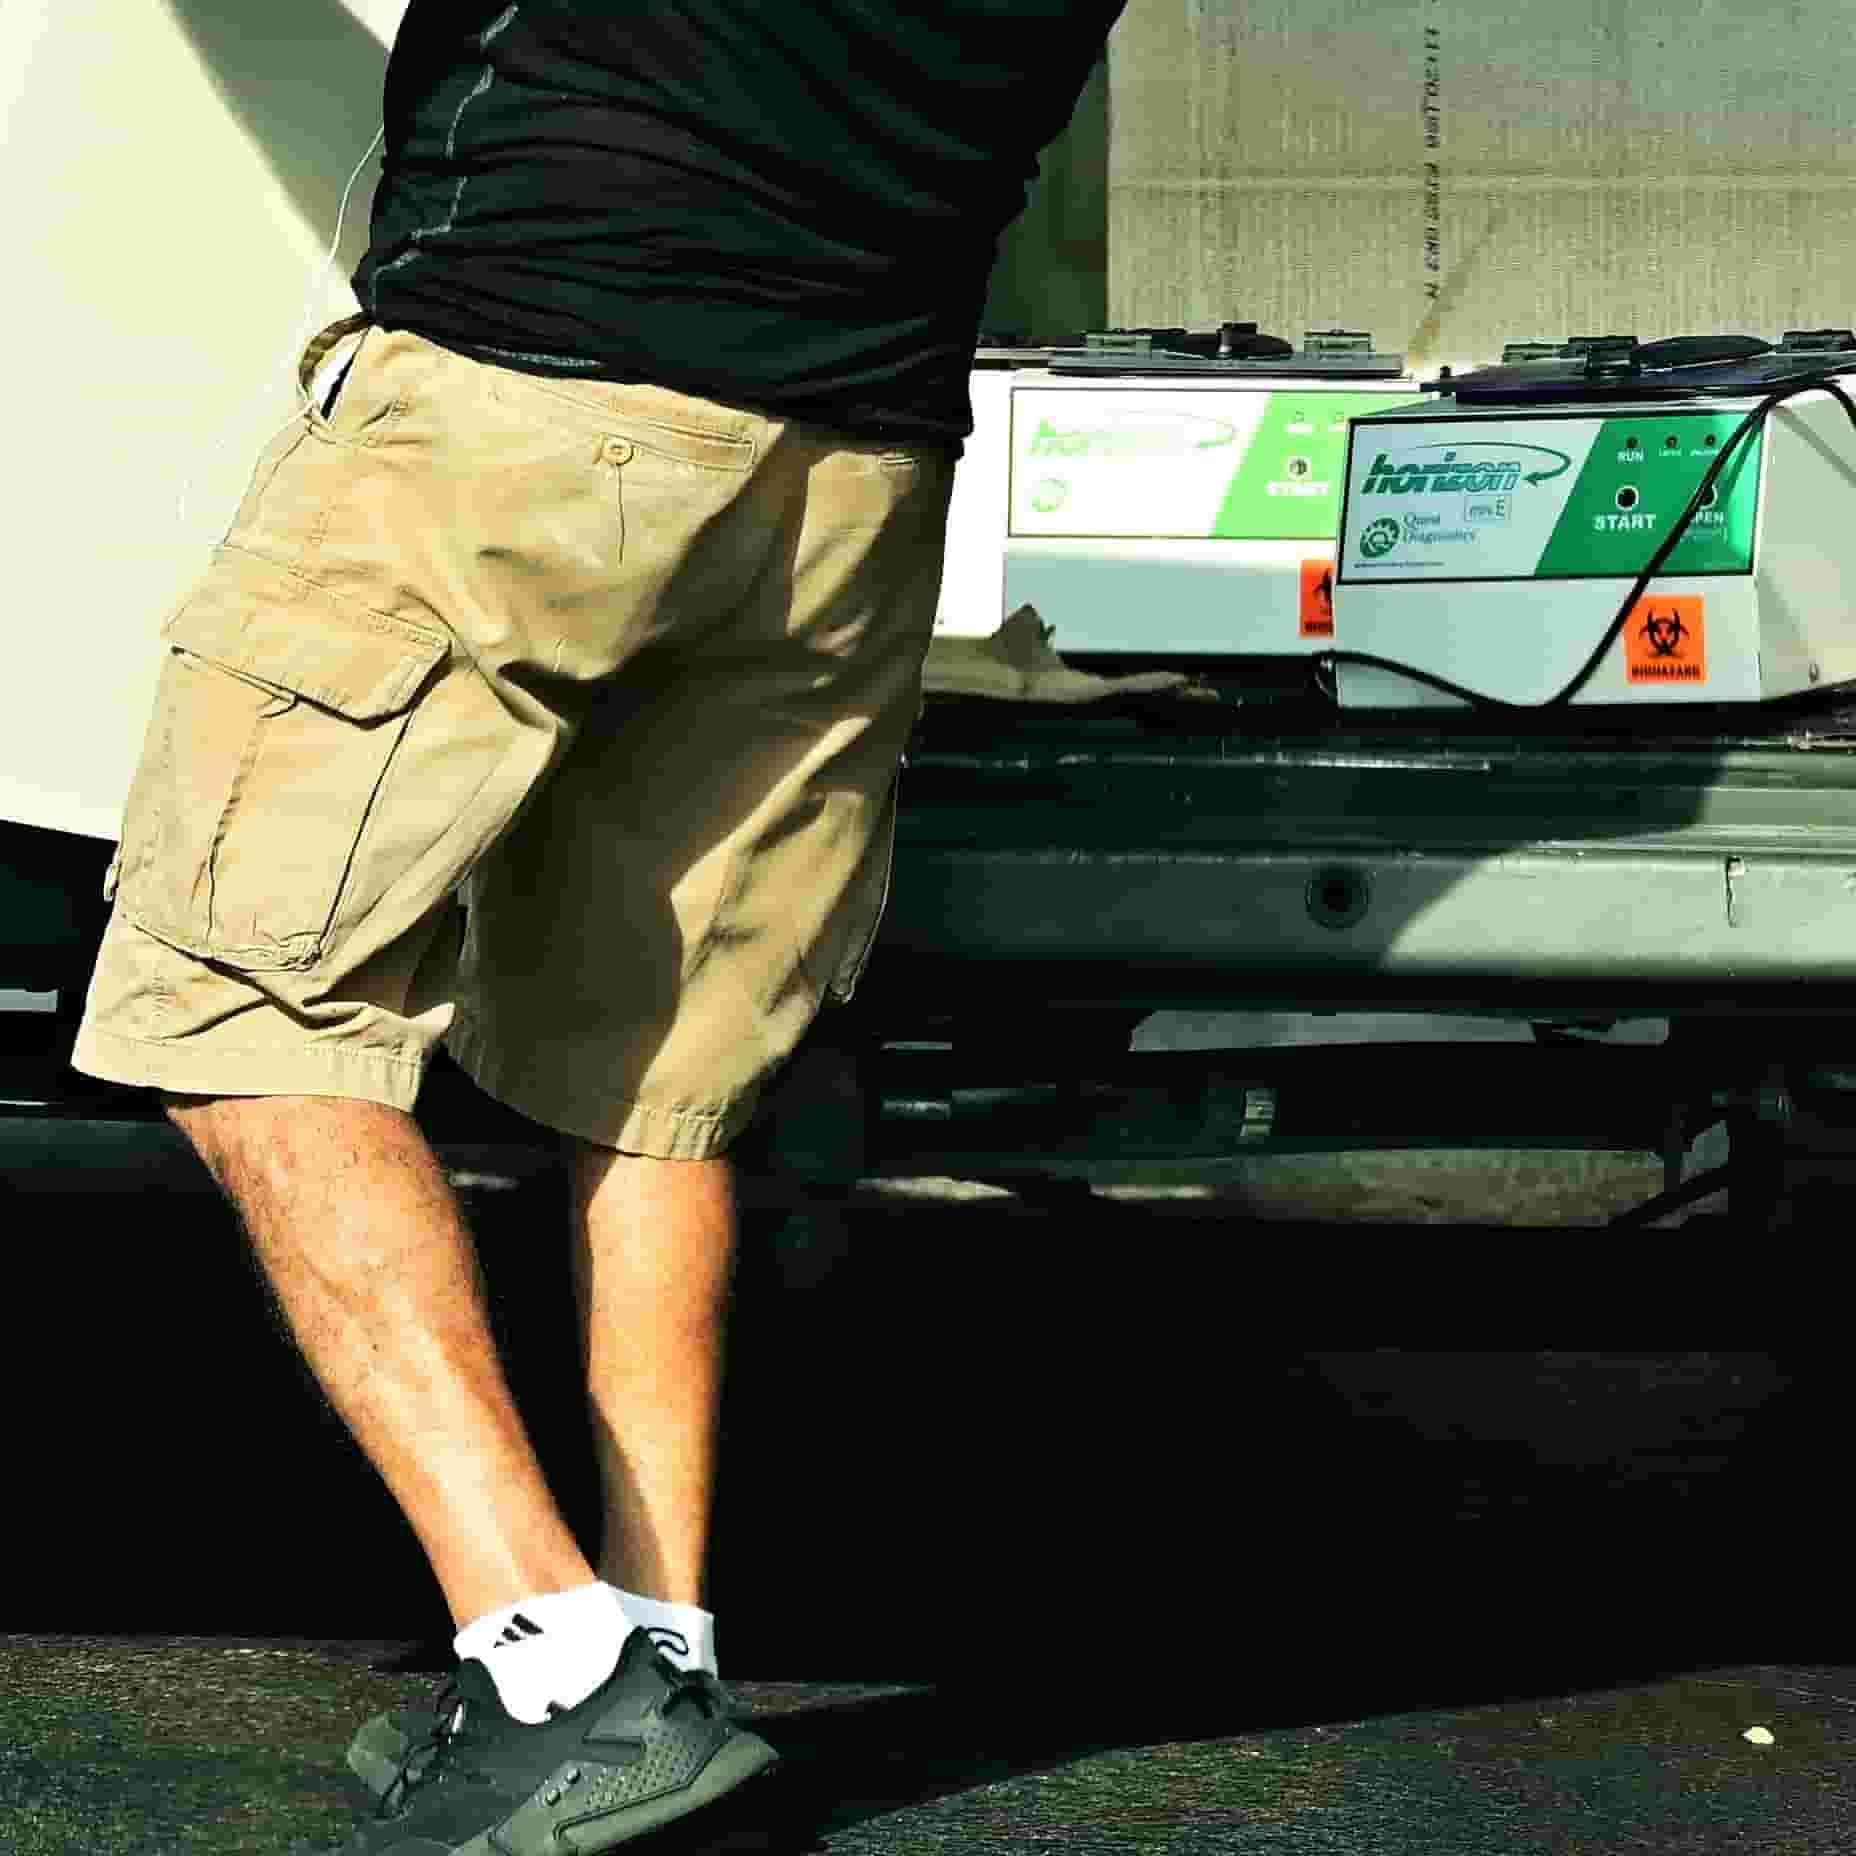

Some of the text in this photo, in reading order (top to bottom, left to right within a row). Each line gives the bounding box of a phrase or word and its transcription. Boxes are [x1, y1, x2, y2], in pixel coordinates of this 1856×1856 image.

[1361, 450, 1521, 494] horizon
[1592, 513, 1657, 531] START
[1694, 511, 1726, 529] PEN
